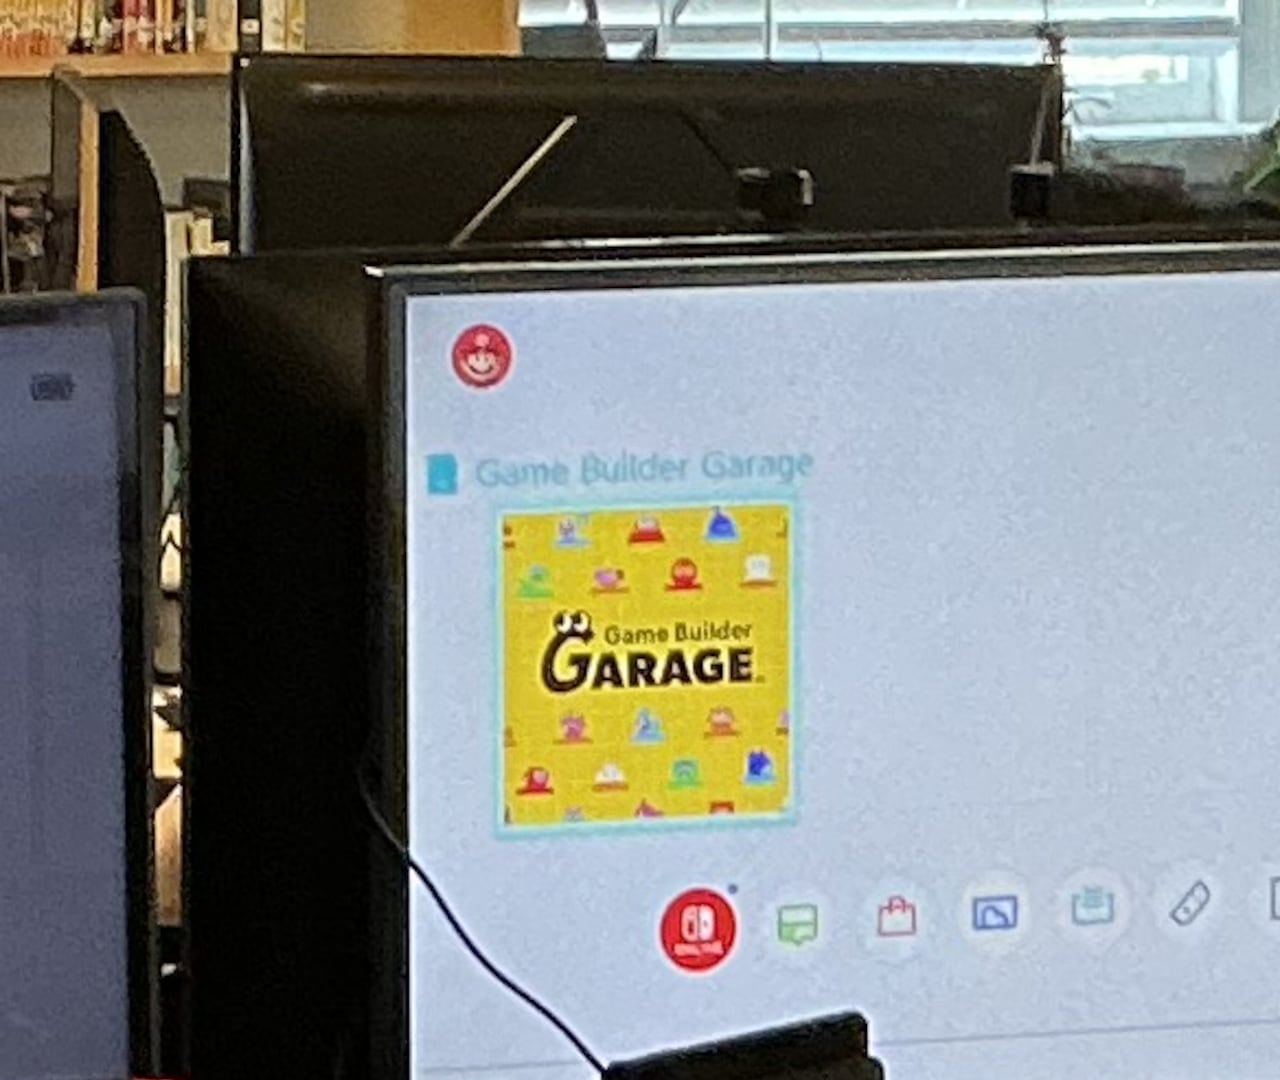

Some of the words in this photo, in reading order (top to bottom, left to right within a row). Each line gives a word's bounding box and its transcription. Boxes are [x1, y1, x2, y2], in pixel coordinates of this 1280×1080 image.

[475, 458, 571, 487] Game
[580, 449, 690, 486] Builder
[700, 449, 815, 484] Garage
[603, 624, 669, 646] Game
[674, 619, 753, 643] Builder
[541, 630, 755, 694] GARAGE
